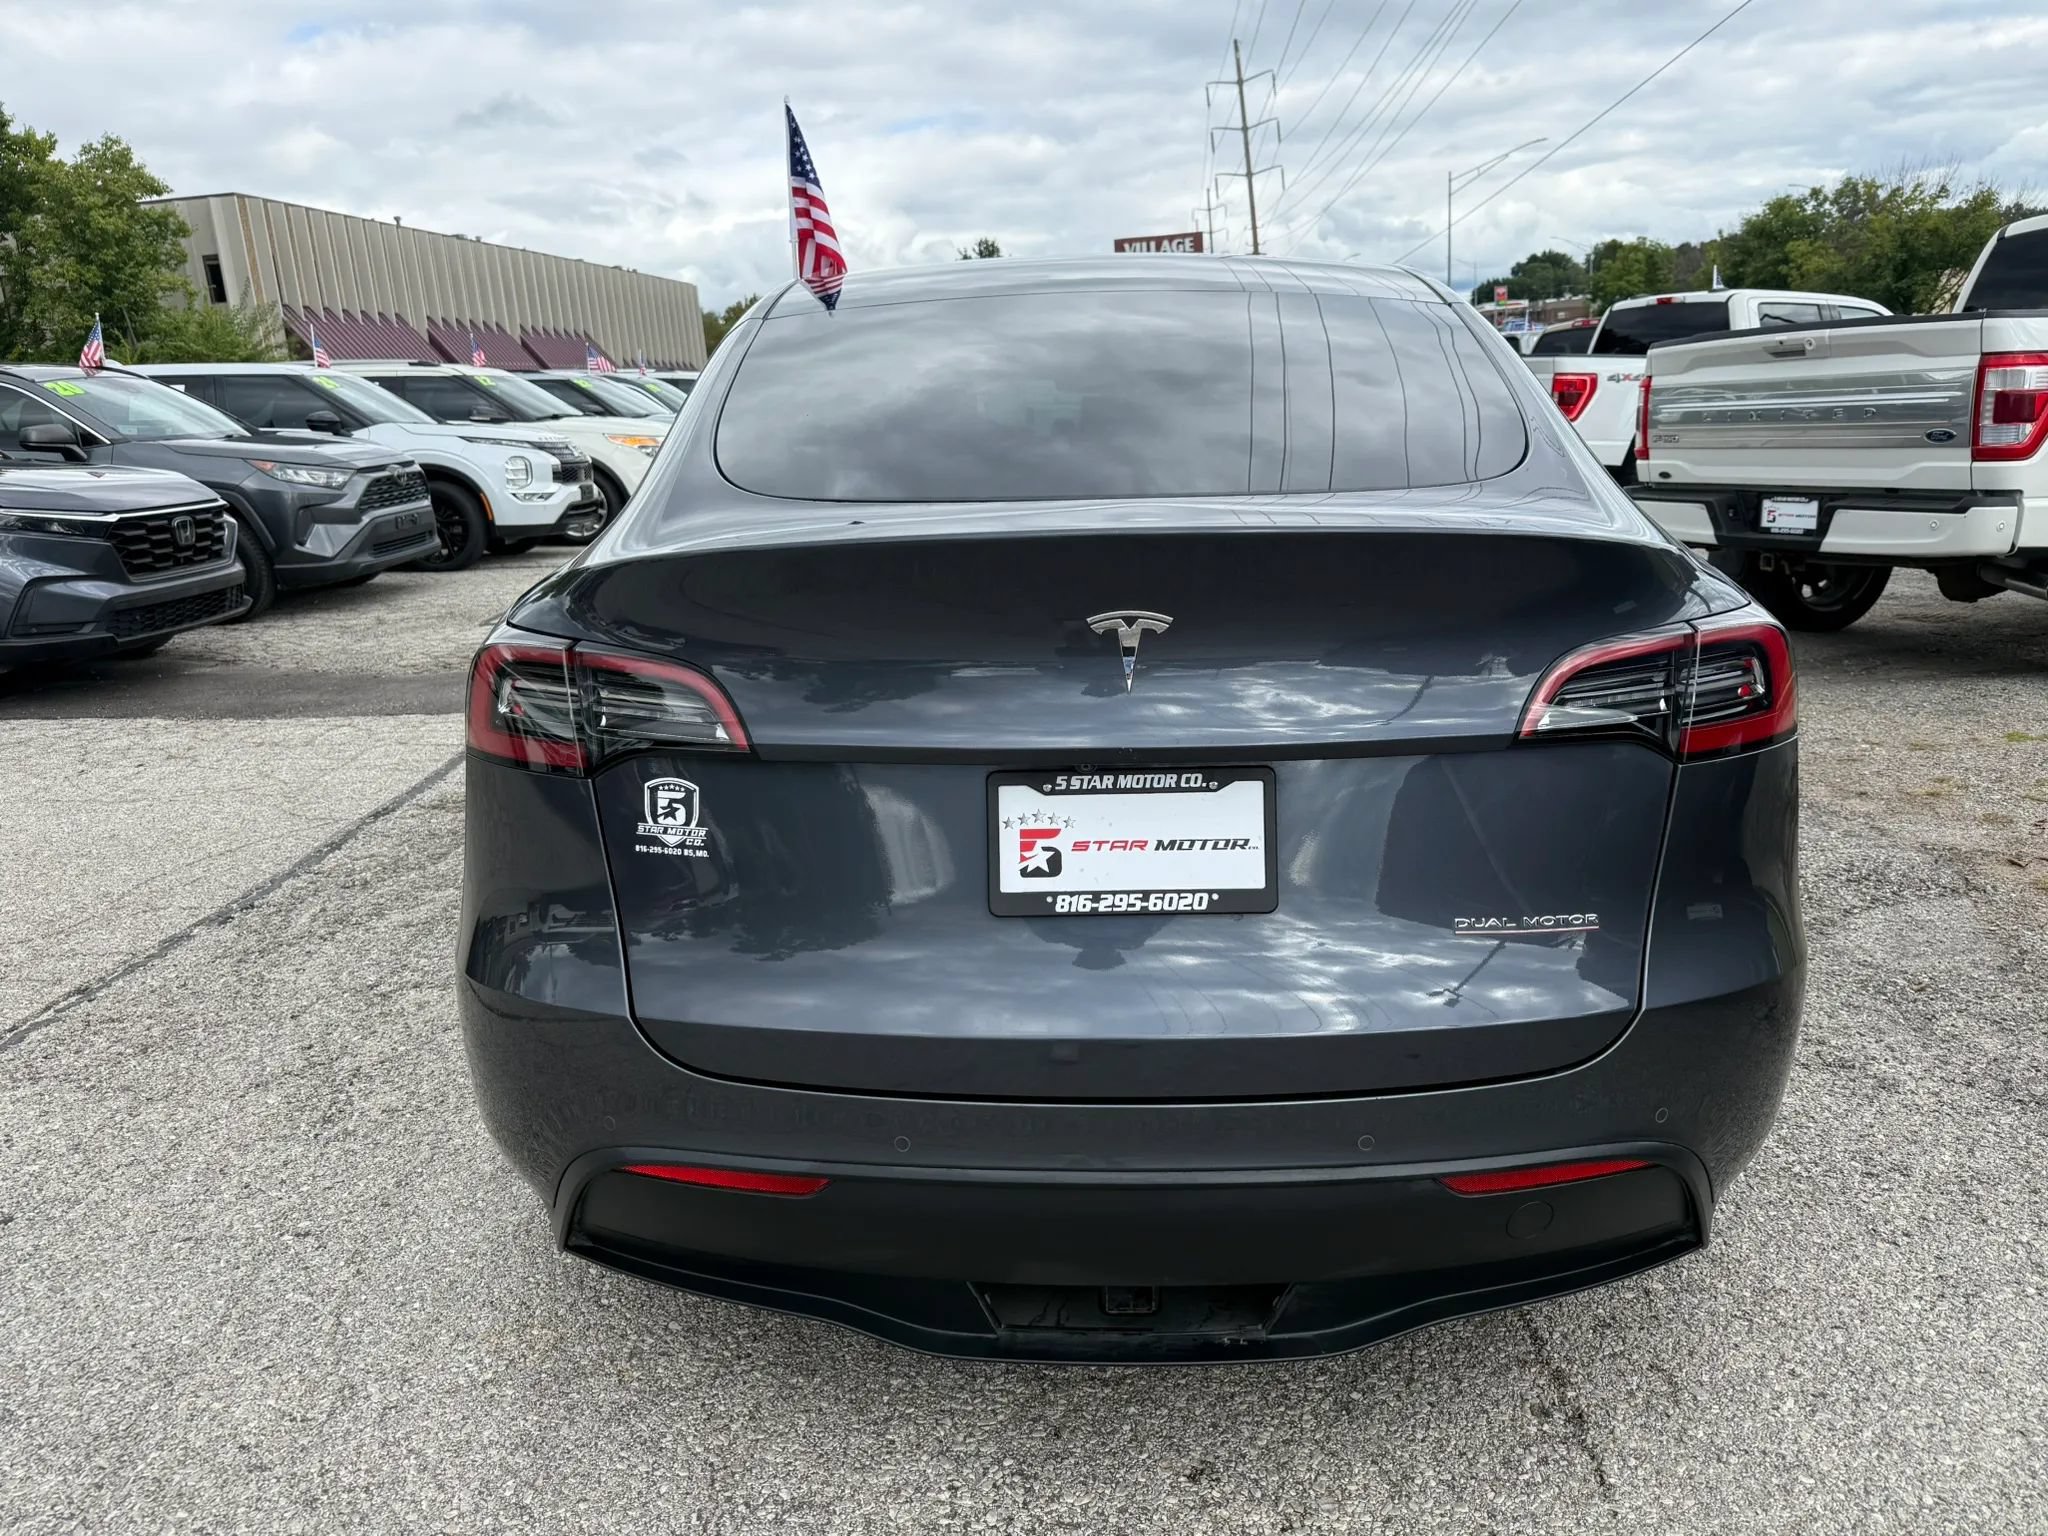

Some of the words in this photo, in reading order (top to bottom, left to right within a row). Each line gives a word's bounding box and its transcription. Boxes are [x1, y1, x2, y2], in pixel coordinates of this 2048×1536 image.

[1123, 237, 1194, 252] VILLAGE
[43, 380, 86, 397] 20
[1703, 407, 1876, 421] LIMITED
[1055, 776, 1070, 790] 5
[1070, 775, 1115, 790] STAR
[1116, 774, 1180, 789] MOTOR
[1181, 773, 1208, 789] CO.
[637, 825, 664, 835] STAR
[667, 827, 707, 838] MOTOR
[685, 838, 705, 847] CO.
[1071, 840, 1149, 851] STAR
[1154, 838, 1250, 851] MOTOR
[635, 844, 682, 856] 816-295-6020
[1055, 892, 1210, 913] 816-295-6020
[1454, 917, 1517, 928] DUAL
[1523, 913, 1599, 926] MOTOR
